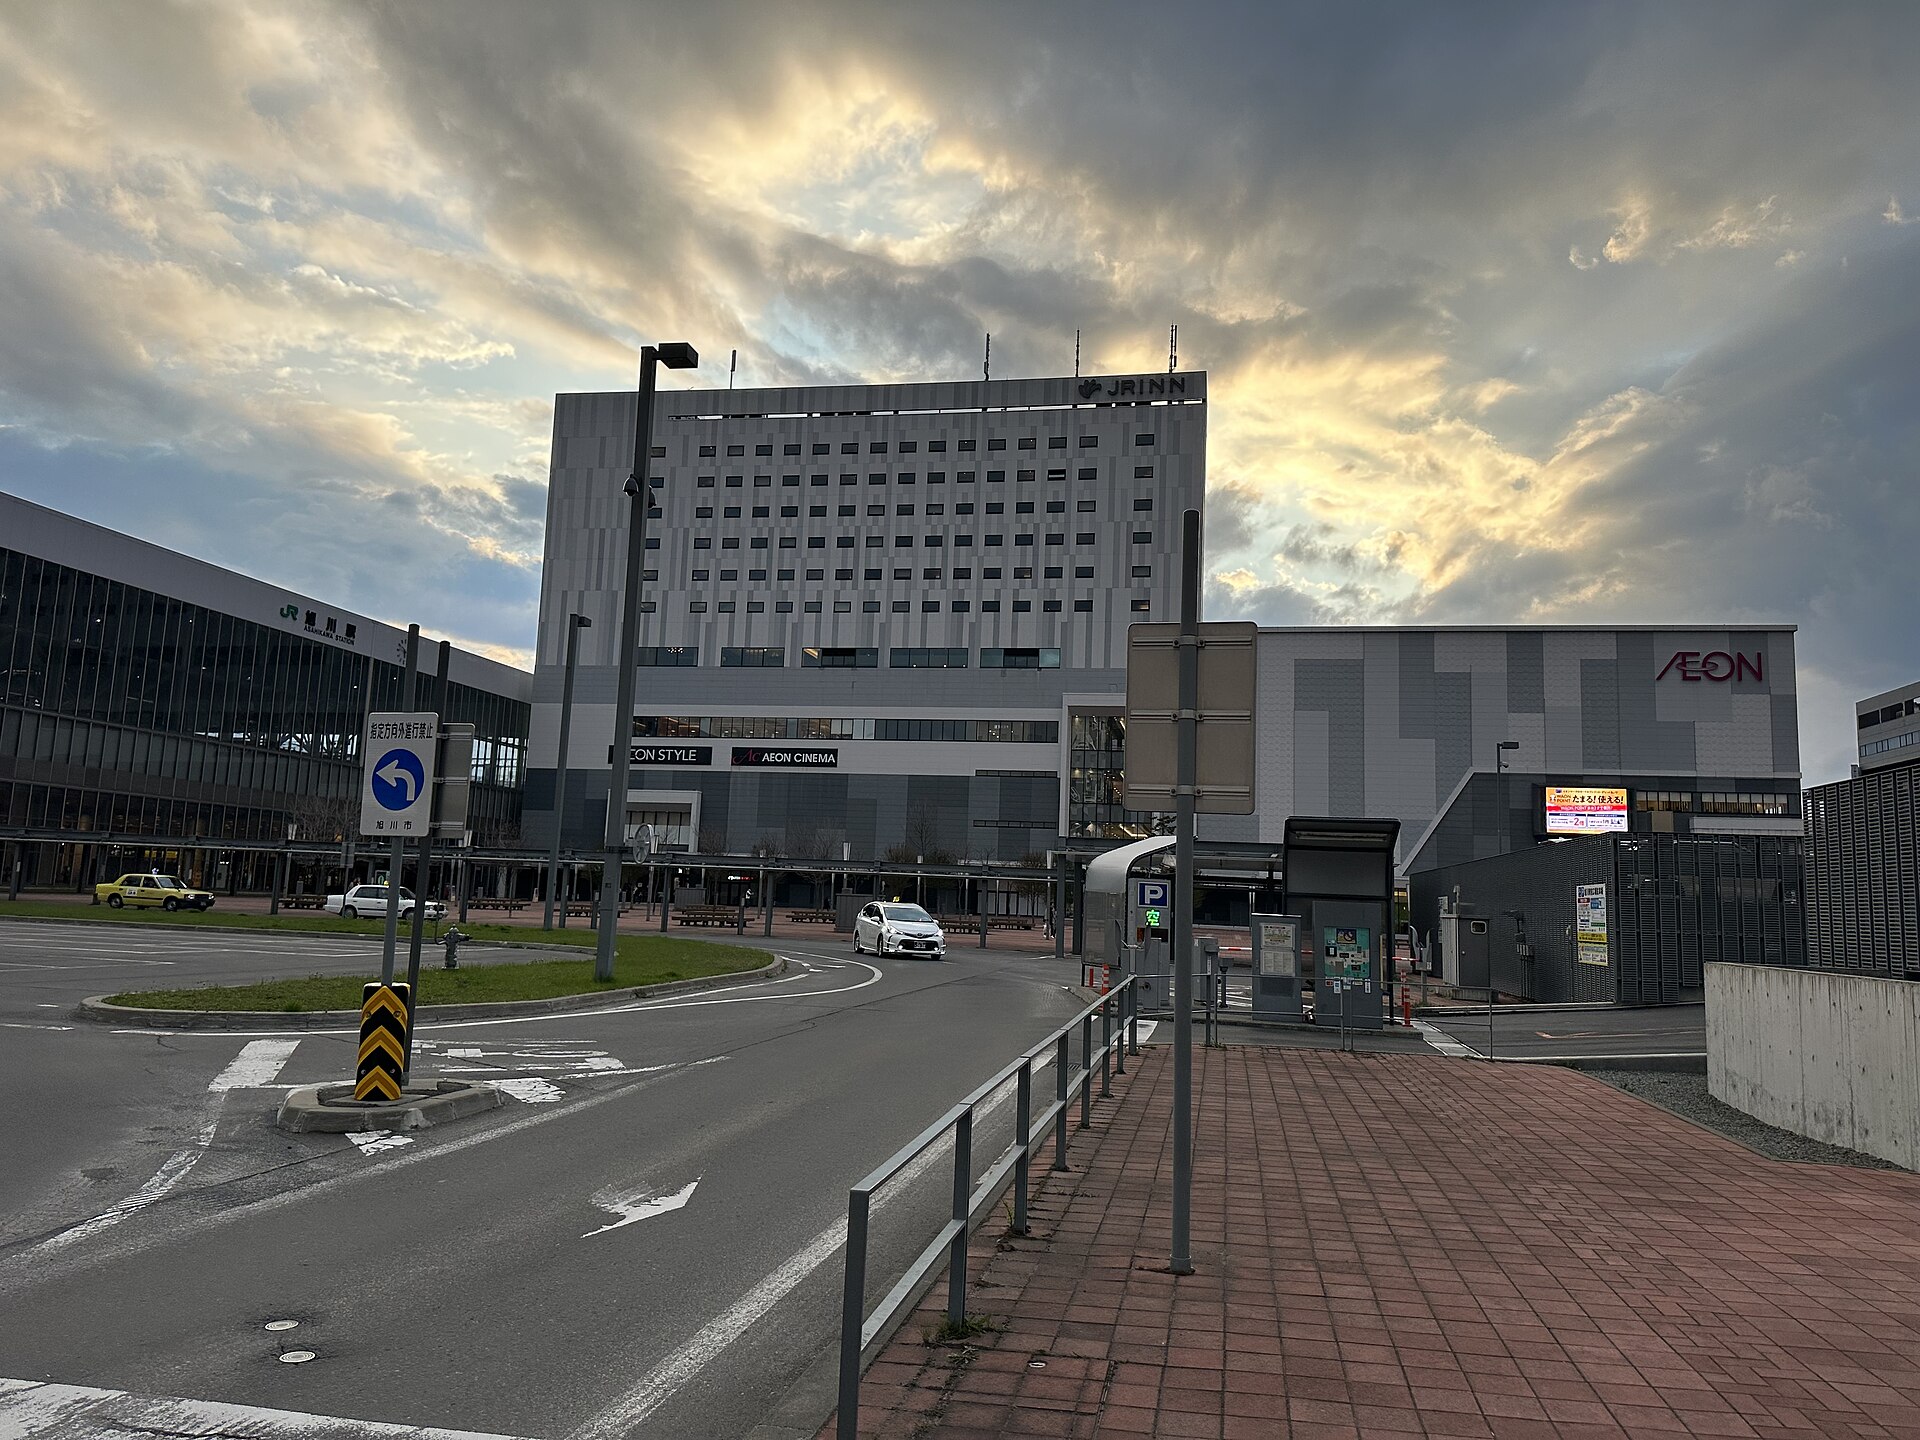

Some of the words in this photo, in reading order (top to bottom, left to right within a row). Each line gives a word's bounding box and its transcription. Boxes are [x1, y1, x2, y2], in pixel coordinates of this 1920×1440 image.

[279, 603, 299, 621] JR
[303, 625, 334, 639] ASAHIKAWA
[335, 634, 355, 646] STATION
[369, 722, 434, 740] 指定方向外進行禁止
[629, 748, 655, 760] EON
[657, 749, 697, 761] STYLE
[761, 752, 791, 763] AEON
[793, 753, 836, 763] CINEMA
[375, 820, 412, 830] 旭川市
[1144, 885, 1164, 904] P
[1145, 909, 1160, 926] 空
